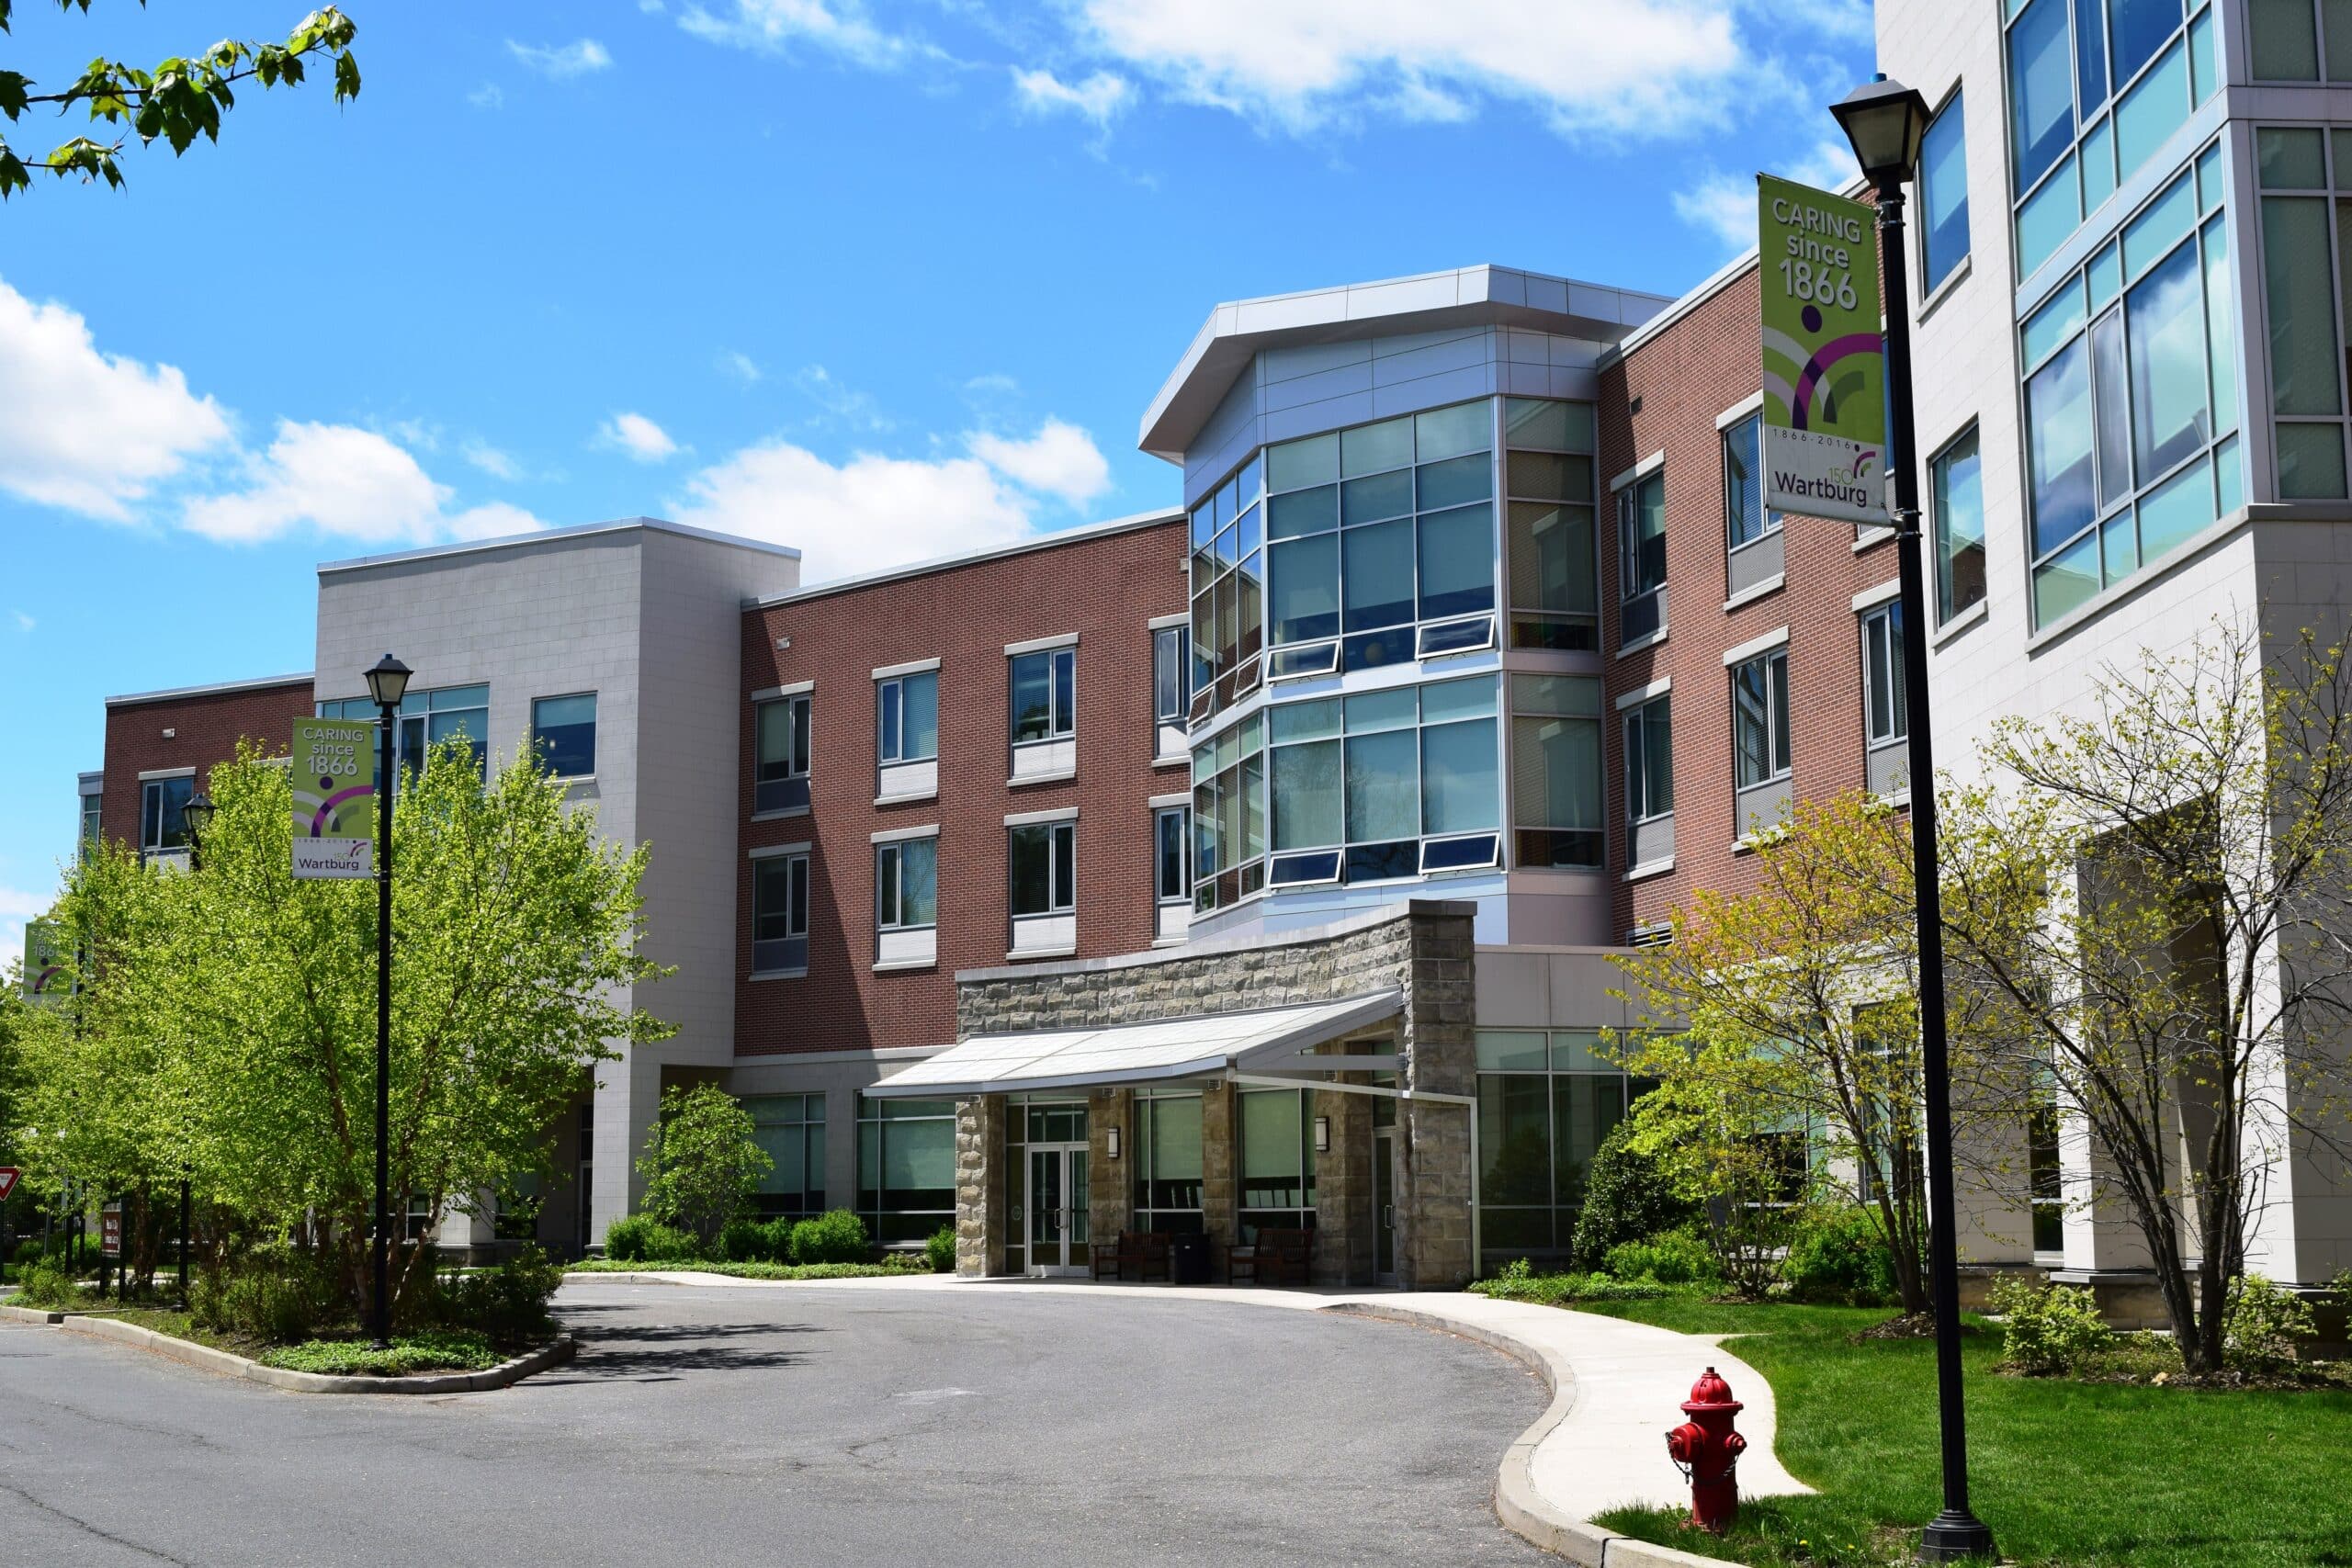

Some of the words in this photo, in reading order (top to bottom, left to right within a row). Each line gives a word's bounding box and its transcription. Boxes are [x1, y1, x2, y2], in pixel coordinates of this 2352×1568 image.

[1772, 198, 1860, 243] CARING
[1787, 231, 1849, 268] since
[1779, 258, 1858, 310] 1866
[1828, 467, 1854, 485] 150
[1775, 470, 1867, 508] Wartburg
[302, 728, 364, 742] CARING
[312, 740, 354, 756] since
[306, 756, 358, 776] 1866
[299, 858, 359, 871] Wartburg
